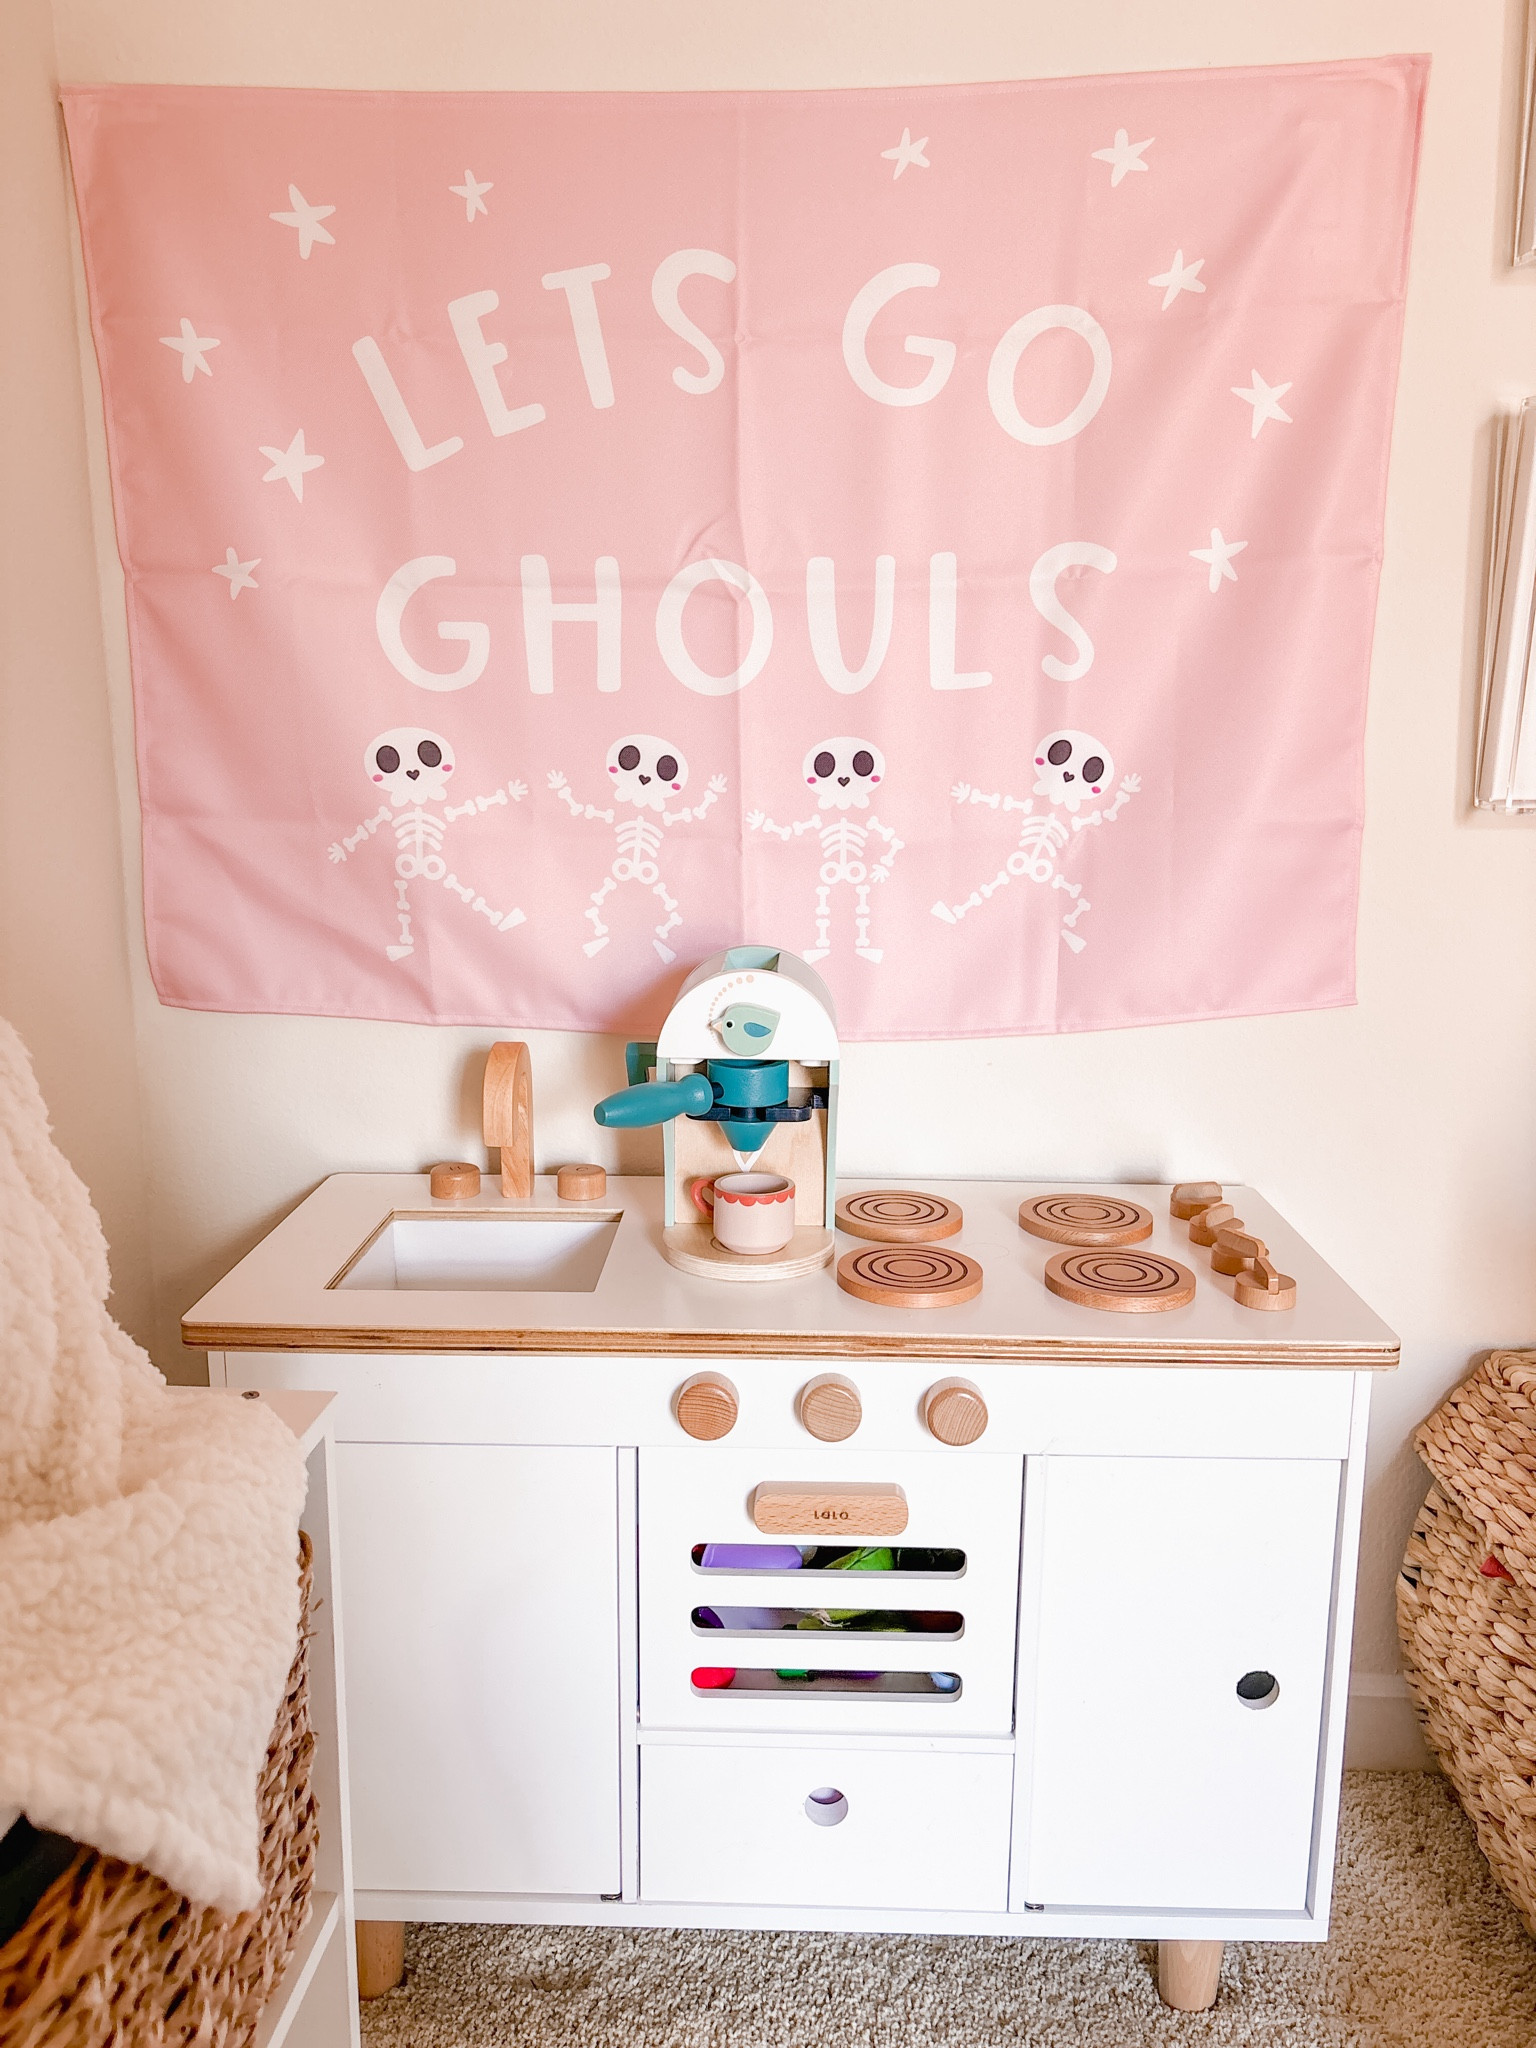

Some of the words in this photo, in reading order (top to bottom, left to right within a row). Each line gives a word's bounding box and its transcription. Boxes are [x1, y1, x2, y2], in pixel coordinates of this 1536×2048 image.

[352, 248, 737, 472] LETS
[842, 262, 1113, 446] GO
[376, 541, 1118, 697] GHOULS
